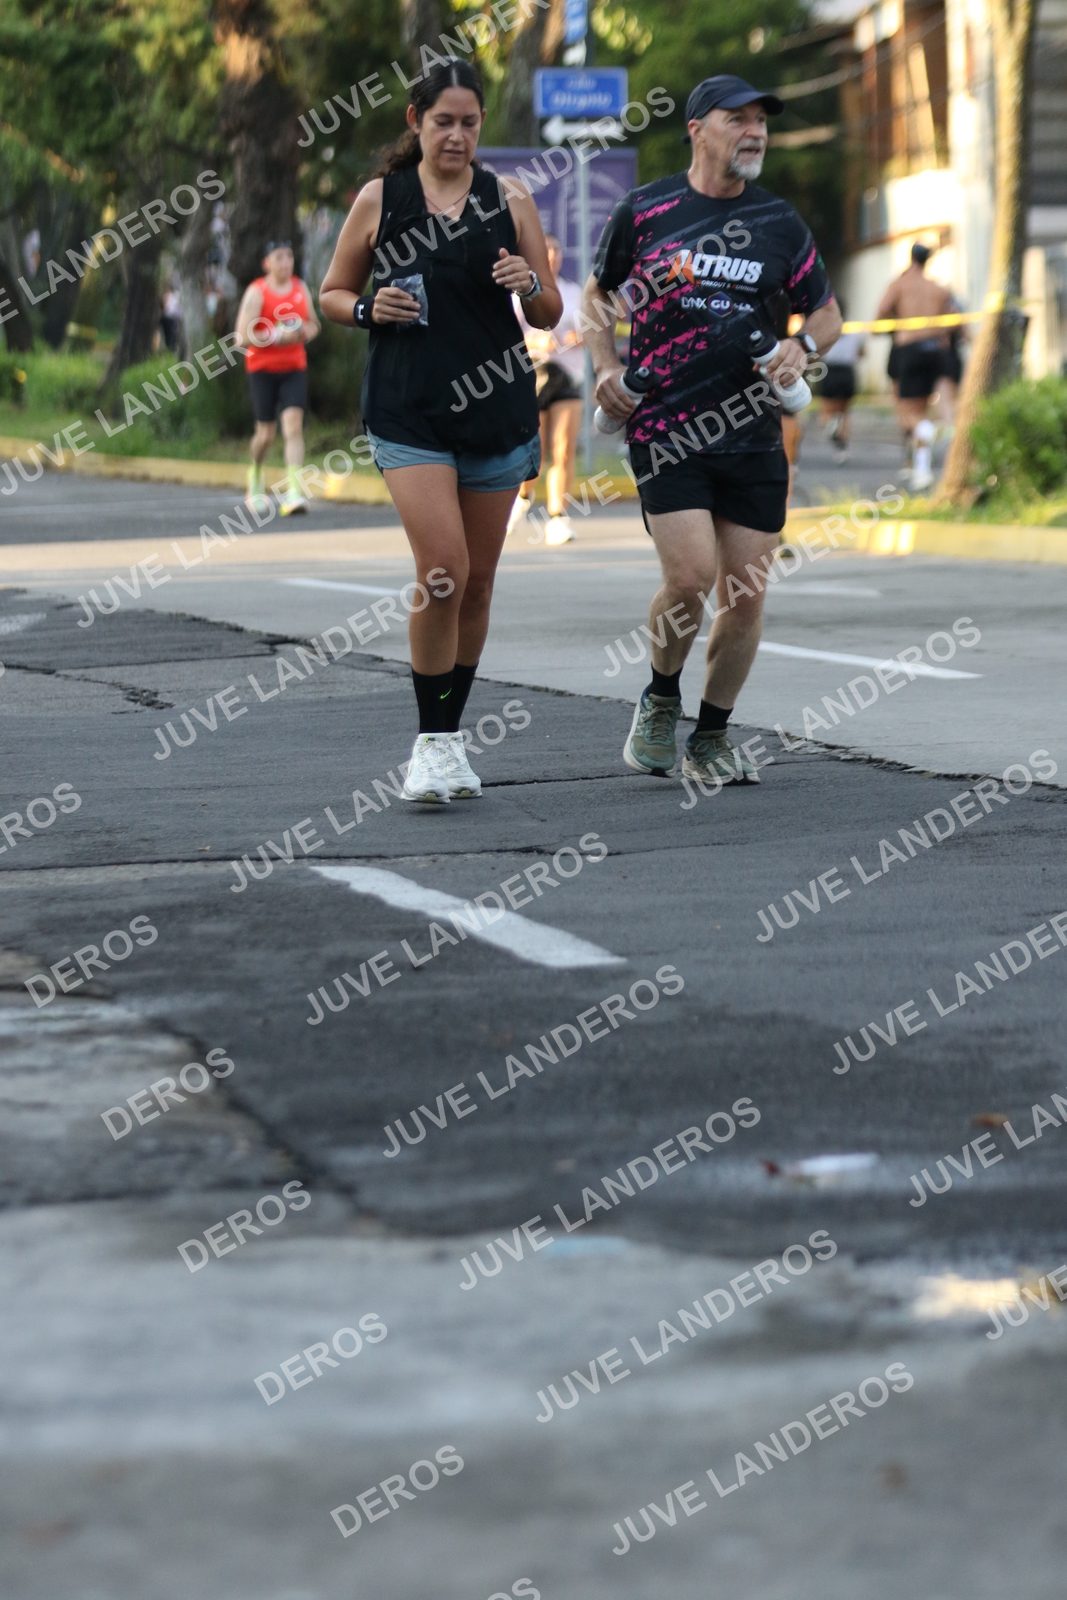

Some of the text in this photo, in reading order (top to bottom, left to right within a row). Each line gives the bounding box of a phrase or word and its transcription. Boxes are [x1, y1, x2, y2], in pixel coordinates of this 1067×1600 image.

[666, 249, 764, 284] ALTRUS
[681, 296, 708, 310] LYNX
[710, 299, 731, 310] GU
